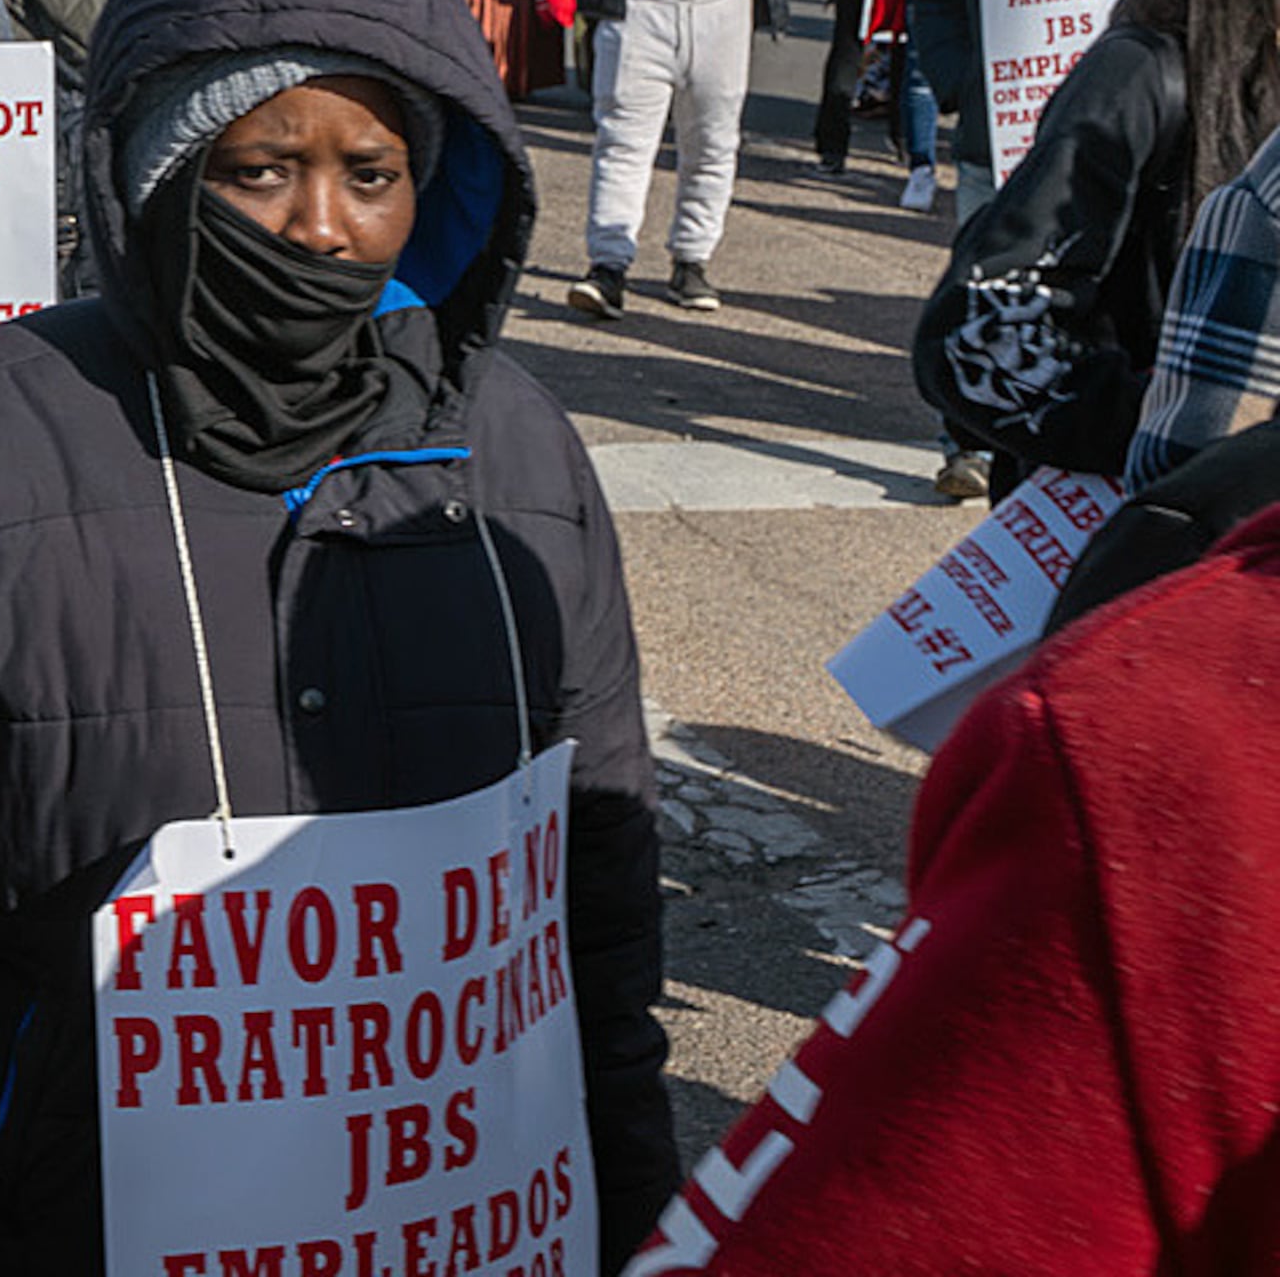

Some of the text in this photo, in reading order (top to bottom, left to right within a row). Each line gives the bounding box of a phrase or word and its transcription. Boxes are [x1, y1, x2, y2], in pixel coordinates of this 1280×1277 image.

[1045, 13, 1094, 45] JBS
[993, 86, 1020, 105] ON
[916, 626, 973, 674] #7
[114, 810, 559, 991] FAVOR DE NO
[113, 920, 568, 1109] PRATROCINAR
[345, 1088, 478, 1212] JBS
